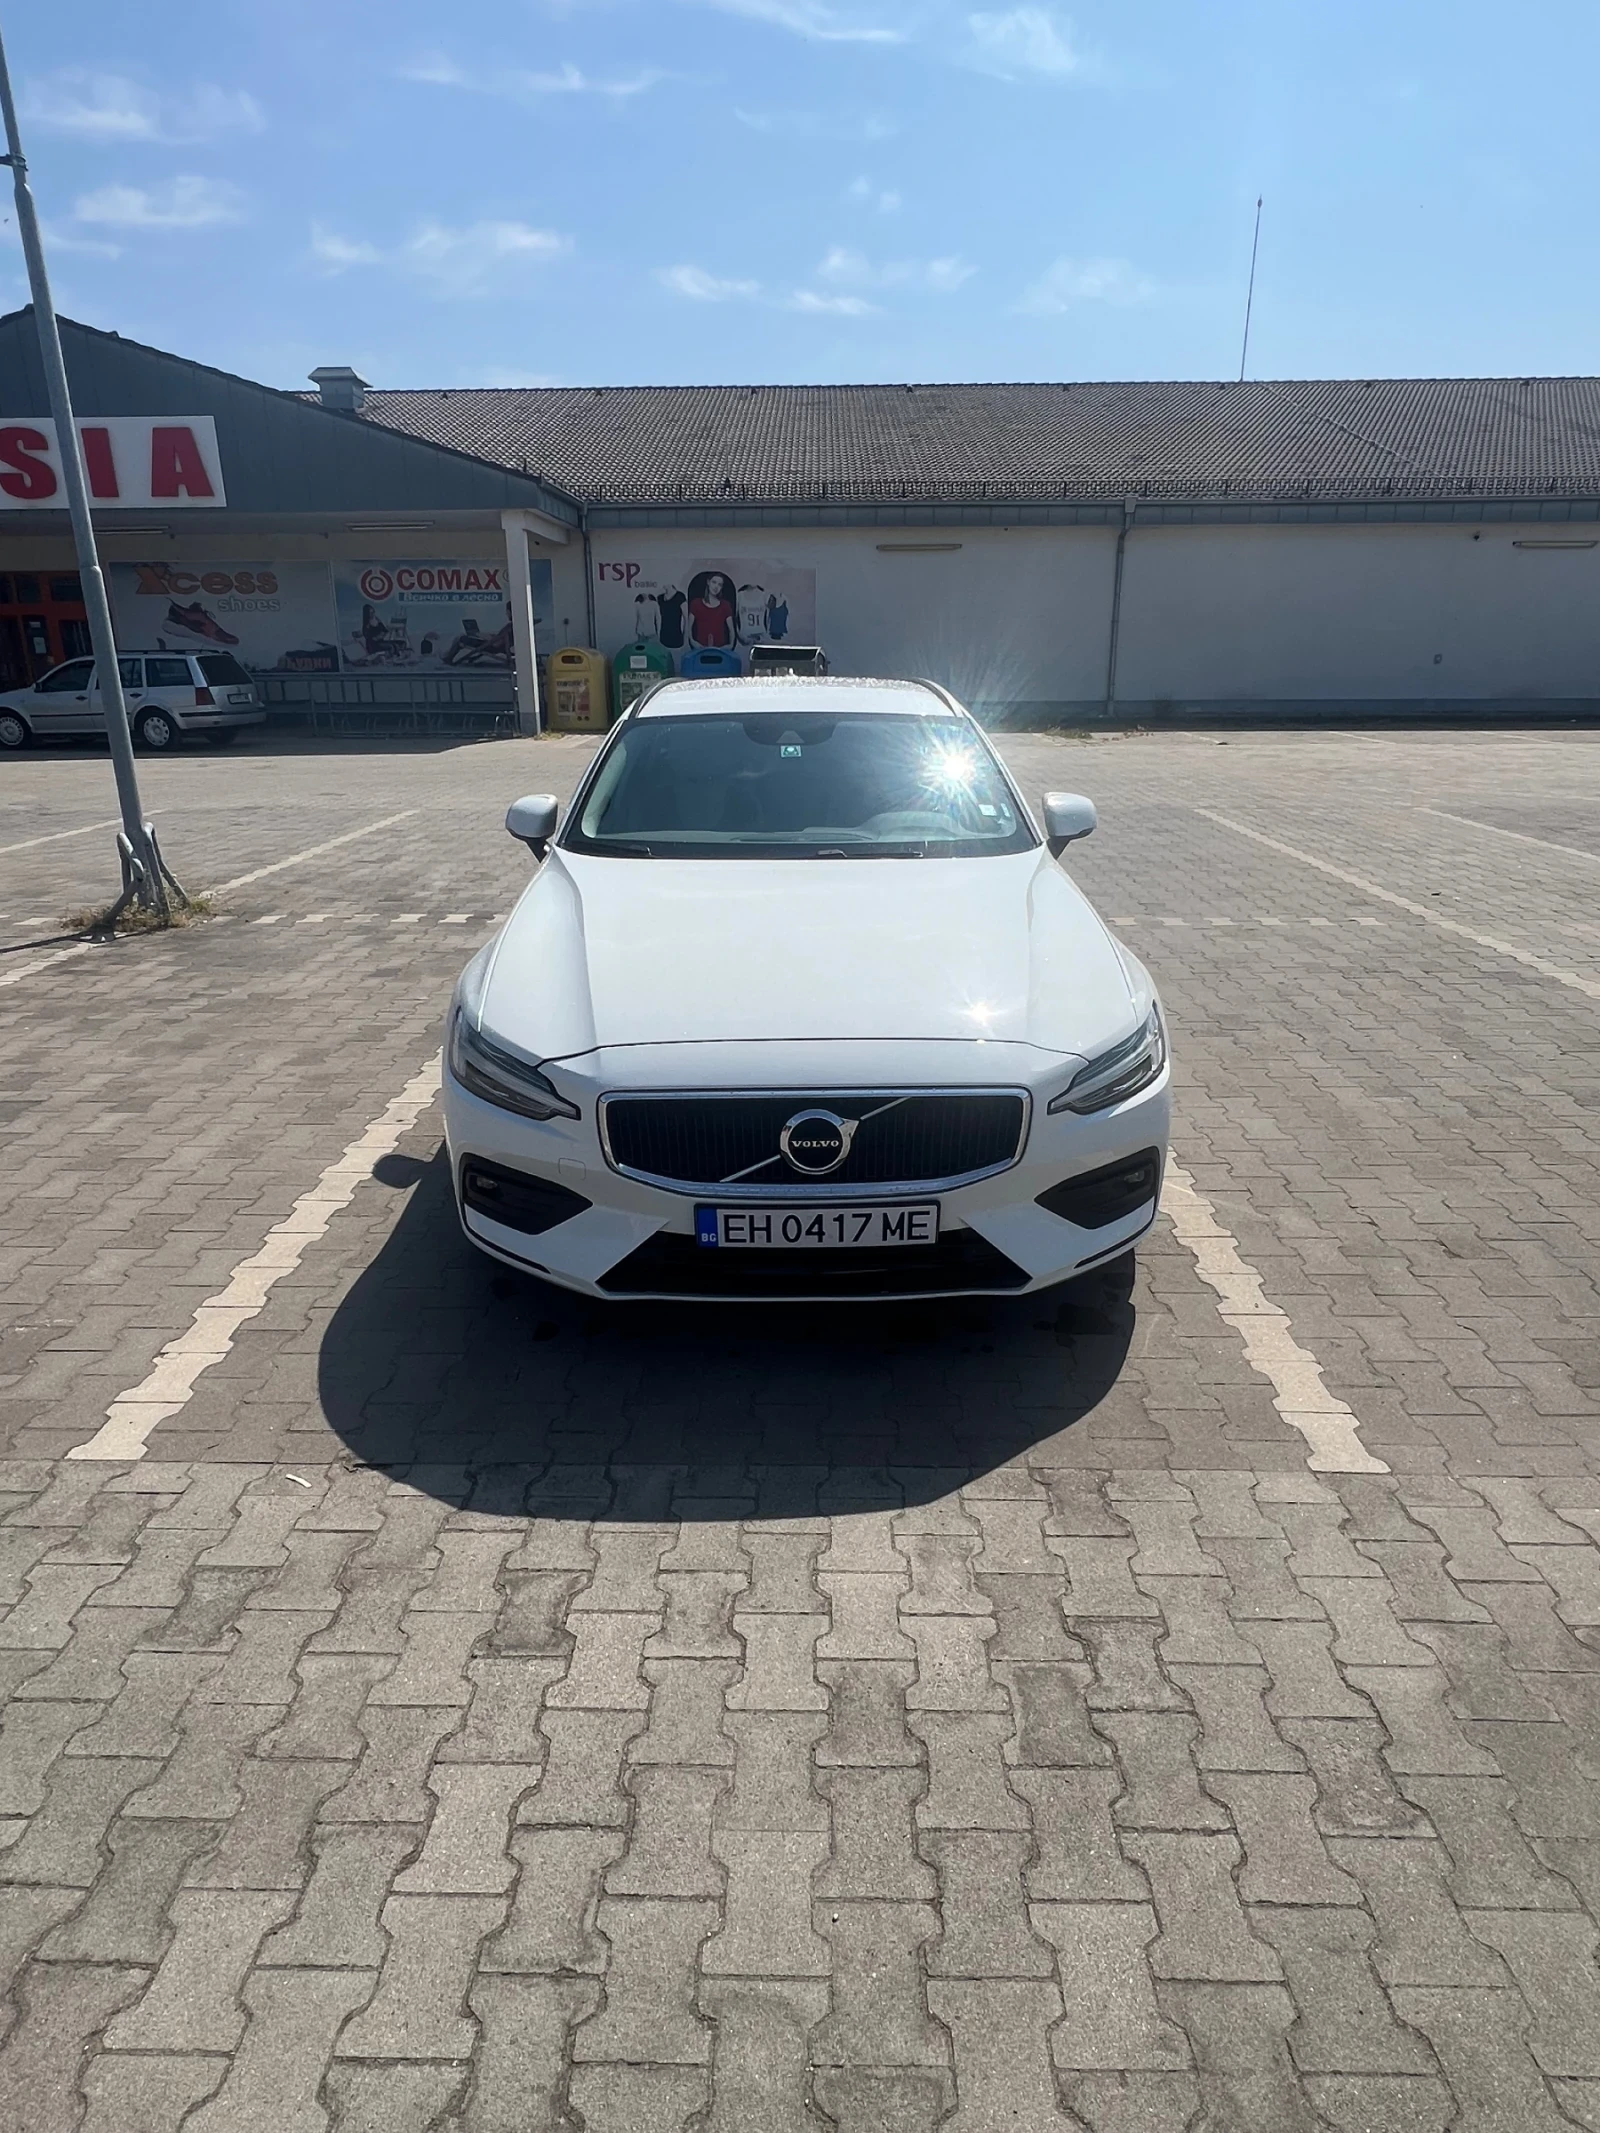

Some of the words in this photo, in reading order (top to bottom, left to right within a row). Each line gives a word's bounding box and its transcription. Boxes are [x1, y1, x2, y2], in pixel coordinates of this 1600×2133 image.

[133, 564, 278, 595] Xcess
[396, 568, 502, 591] COMAX
[598, 562, 641, 588] rsp
[634, 580, 658, 589] basic
[217, 596, 281, 612] shoes
[462, 593, 500, 602] лесно
[747, 613, 760, 627] 91
[791, 1139, 839, 1148] VOLVO
[723, 1213, 772, 1243] EH
[781, 1213, 873, 1243] 0417
[882, 1211, 931, 1241] ME
[701, 1233, 717, 1242] BG
